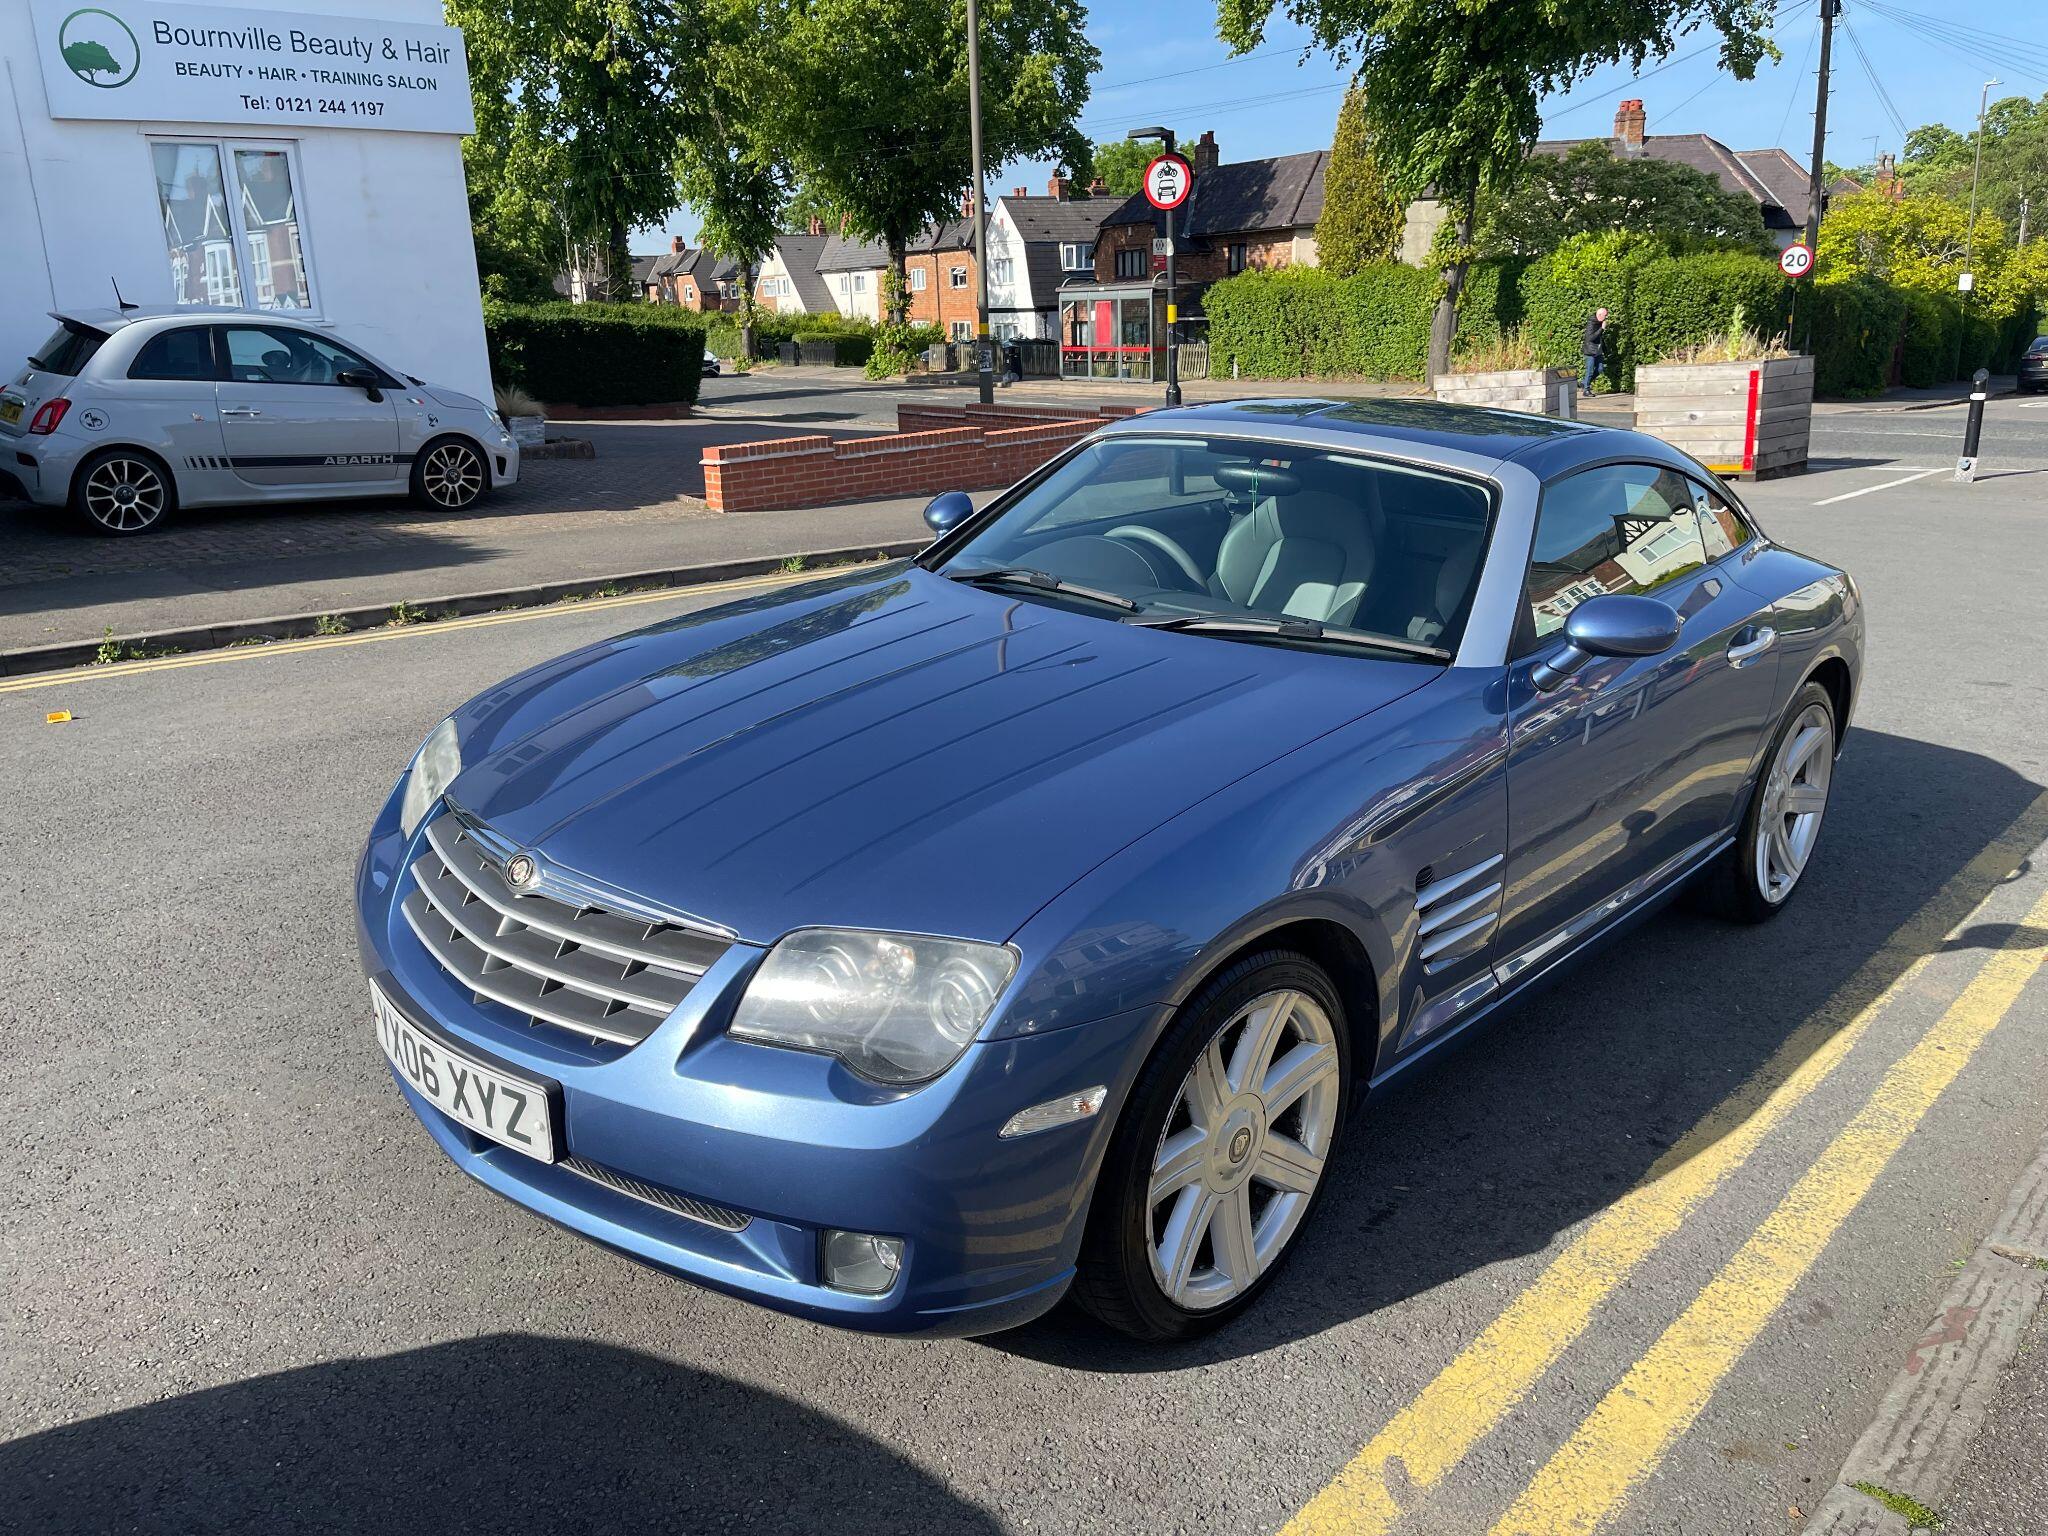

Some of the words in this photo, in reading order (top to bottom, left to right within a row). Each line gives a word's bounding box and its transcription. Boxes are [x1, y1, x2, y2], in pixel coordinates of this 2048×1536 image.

[152, 20, 282, 52] Bournville
[290, 30, 373, 63] Beauty
[382, 37, 398, 60] &
[405, 39, 451, 64] Hair
[175, 61, 243, 78] BEAUTY
[257, 66, 298, 82] HAIR
[310, 69, 383, 87] TRAINING
[387, 75, 438, 91] SALON
[240, 94, 270, 110] Tel:
[275, 96, 312, 112] 0121
[318, 99, 346, 114] 244
[351, 101, 385, 116] 1197
[1785, 253, 1808, 266] 20
[323, 454, 395, 465] ABARTH
[448, 1061, 532, 1145] XYZ
